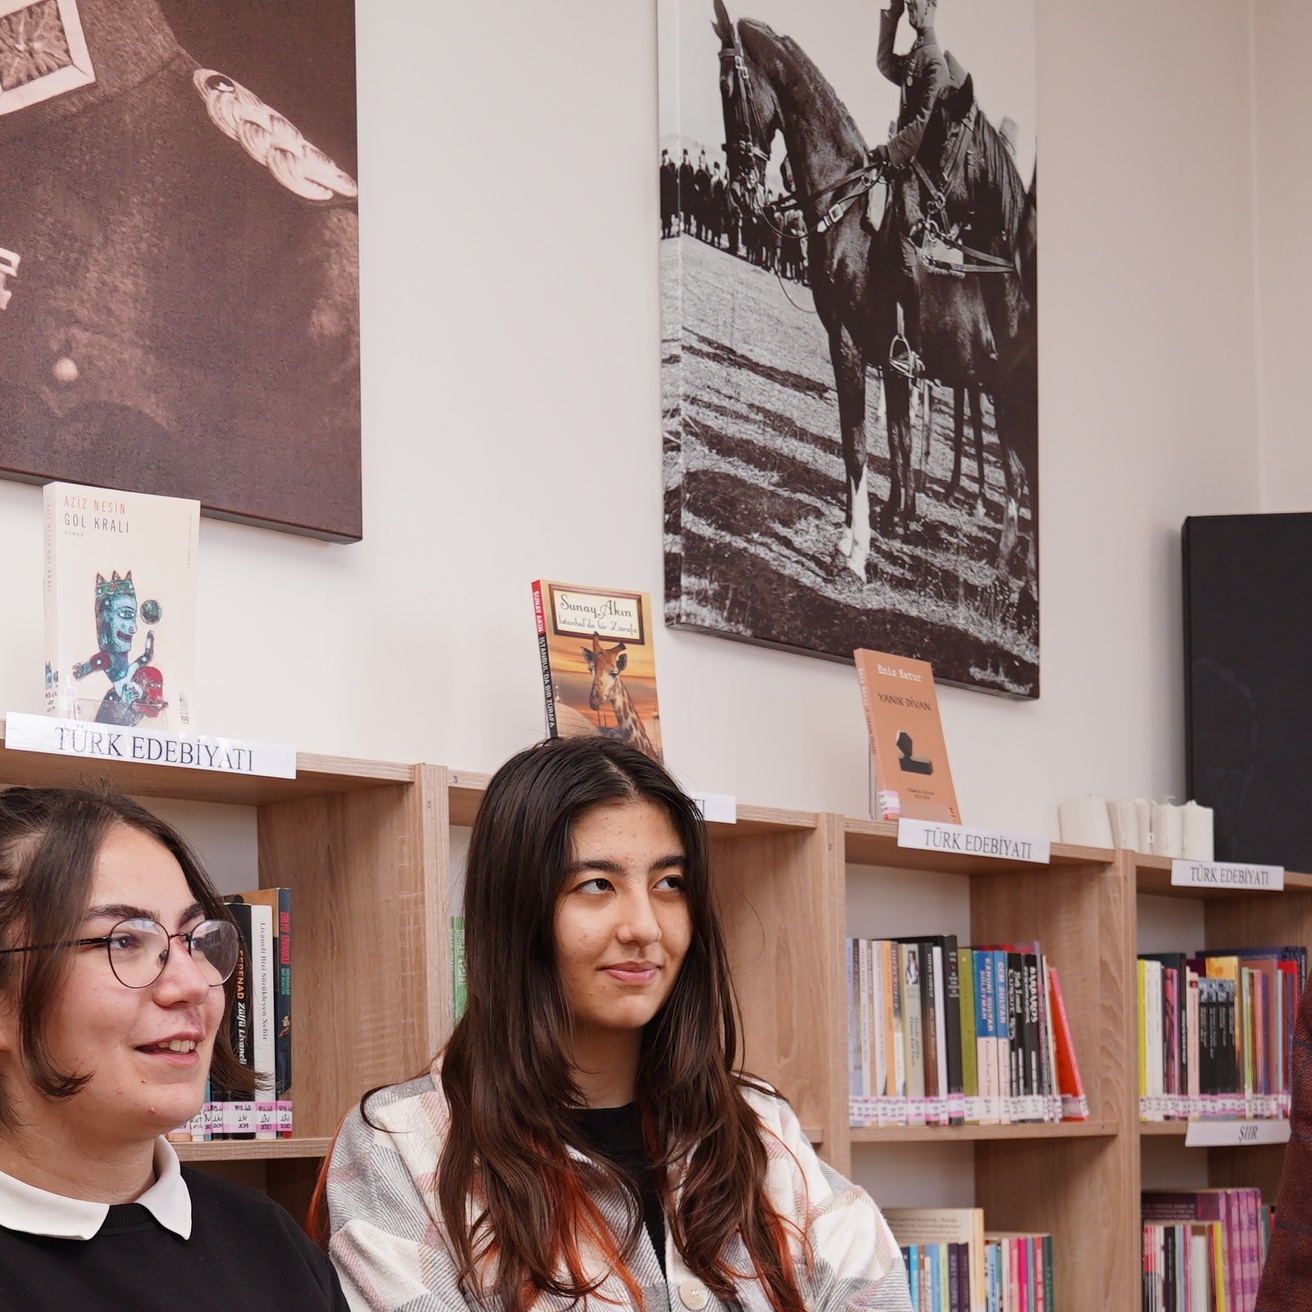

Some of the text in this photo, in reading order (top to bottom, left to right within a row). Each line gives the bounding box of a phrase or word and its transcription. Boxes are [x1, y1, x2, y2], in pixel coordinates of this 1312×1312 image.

[64, 495, 126, 515] AZİZ NESİN
[64, 512, 129, 533] GOL KRALI
[533, 591, 544, 632] SUNAY AKIN
[560, 594, 632, 619] Sunay Akın
[877, 664, 897, 675] Enis
[546, 698, 556, 728] ZÜRAFA
[877, 692, 932, 712] YANIK DİVAN
[55, 724, 256, 772] TÜRK EDEBİYATI
[924, 827, 1031, 859] TÜRK EDEBİYATI
[1190, 864, 1270, 886] TÜRK EDEBİYATI
[280, 911, 292, 965] ZÜLFÜ LİVANELİ
[259, 972, 268, 1017] Sürükleyen
[236, 1002, 245, 1027] Zülfü
[261, 1018, 269, 1041] Nehir
[238, 1028, 247, 1065] Livaneli
